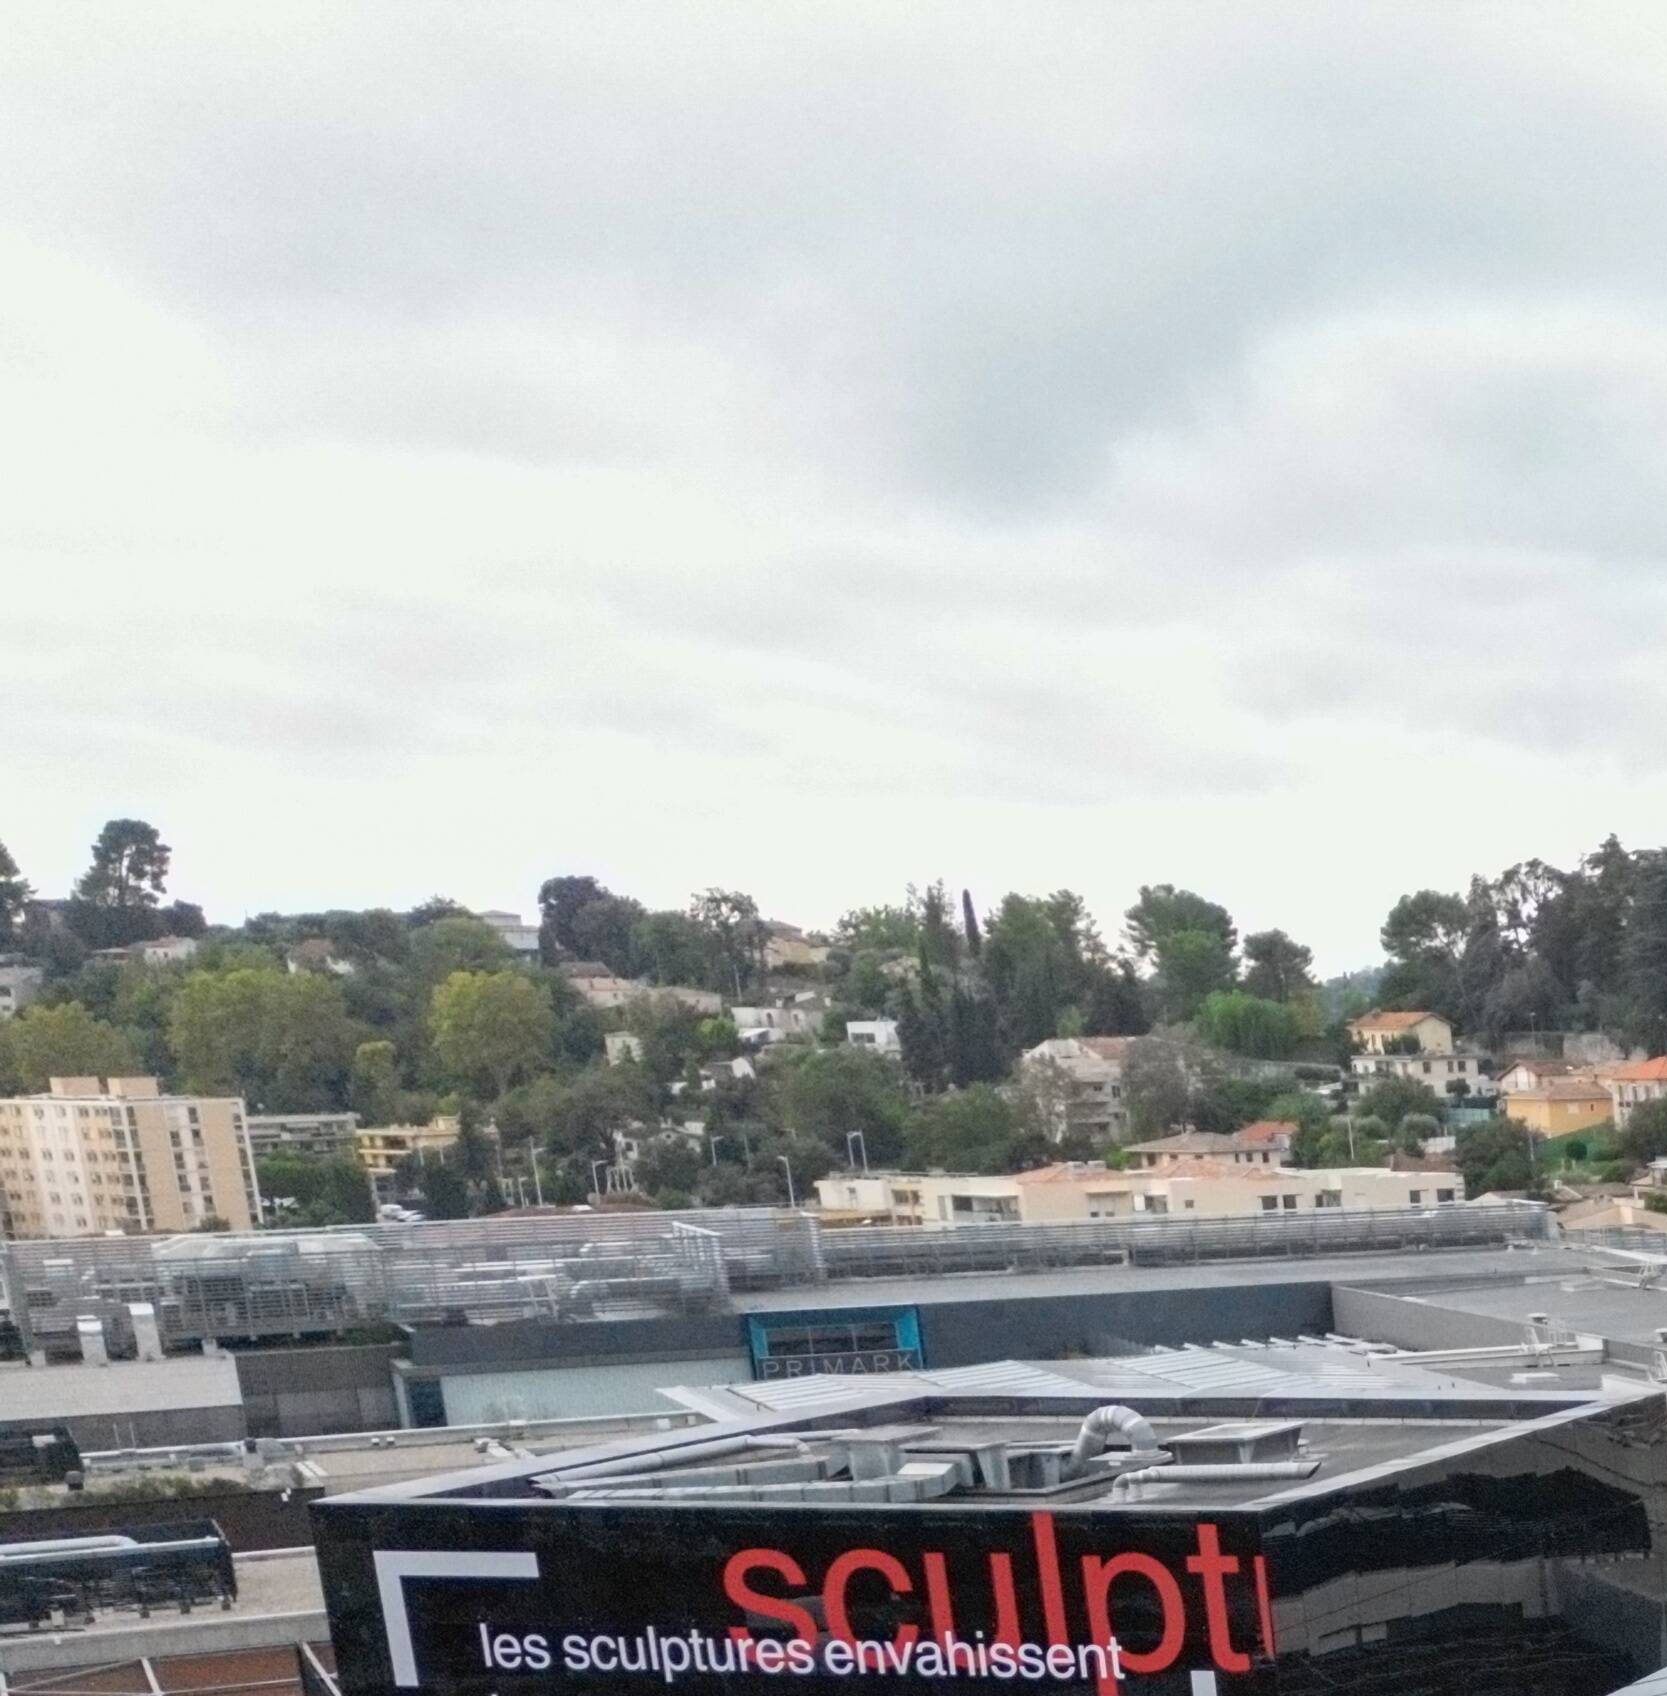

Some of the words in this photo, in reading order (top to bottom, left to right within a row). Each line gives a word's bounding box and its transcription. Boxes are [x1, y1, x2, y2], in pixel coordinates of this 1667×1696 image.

[762, 1353, 914, 1381] PRIMARK
[479, 1622, 551, 1669] les
[563, 1625, 815, 1683] sculptures
[824, 1630, 1126, 1680] envahissent
